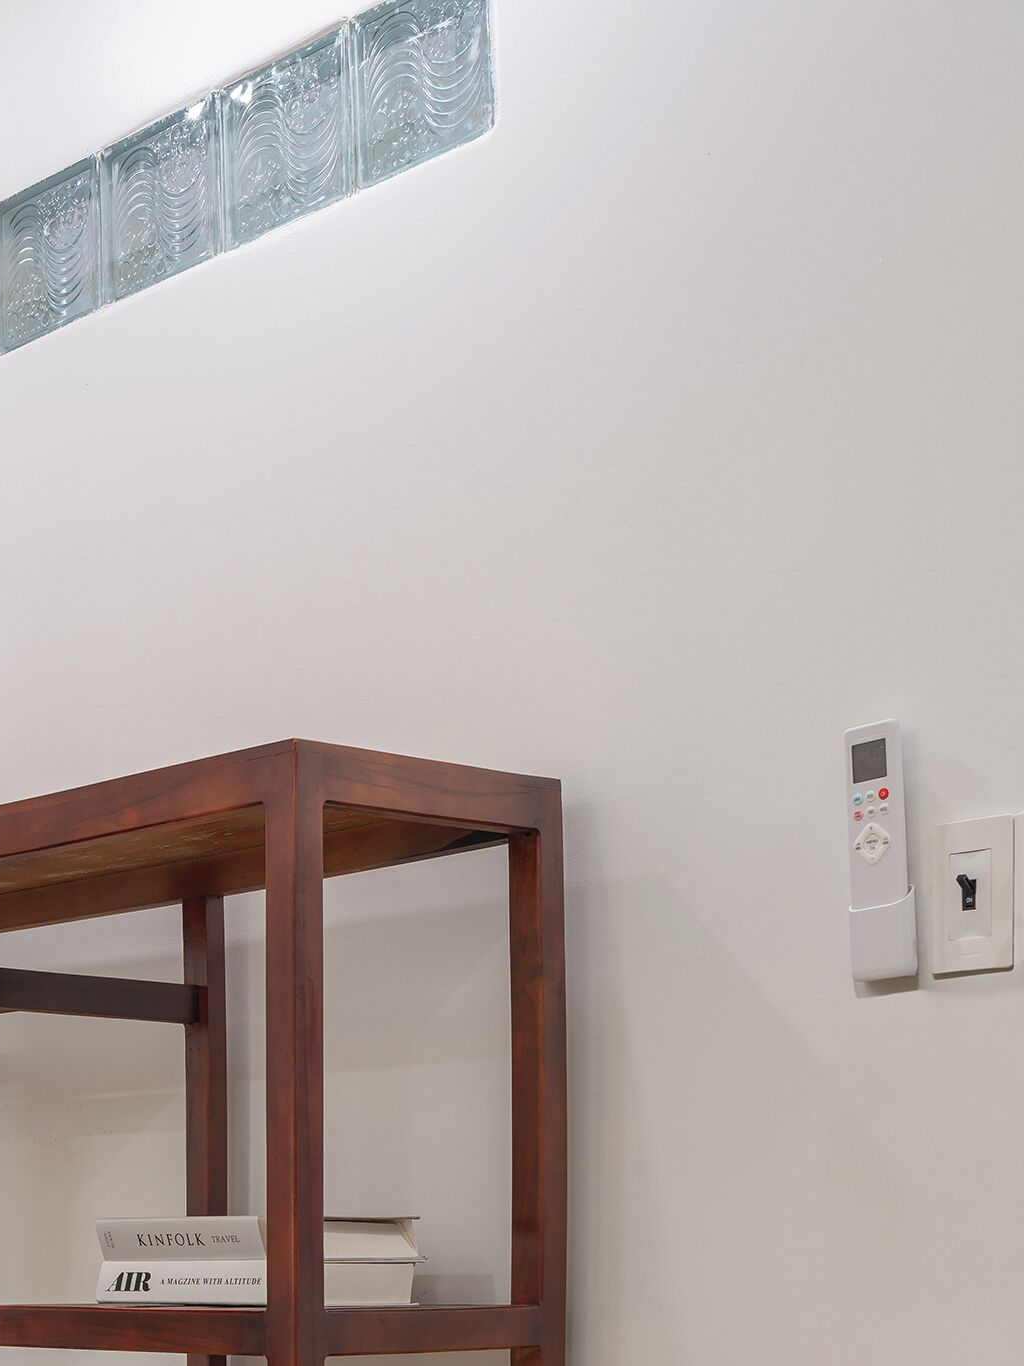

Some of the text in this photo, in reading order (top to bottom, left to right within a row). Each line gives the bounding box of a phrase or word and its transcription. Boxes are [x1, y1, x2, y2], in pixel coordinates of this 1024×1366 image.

[136, 1232, 241, 1247] KINFOLK TRAVEL
[105, 1271, 152, 1293] AIR
[159, 1278, 165, 1286] A
[202, 1277, 223, 1286] WITH
[223, 1277, 263, 1286] ALTITUDE
